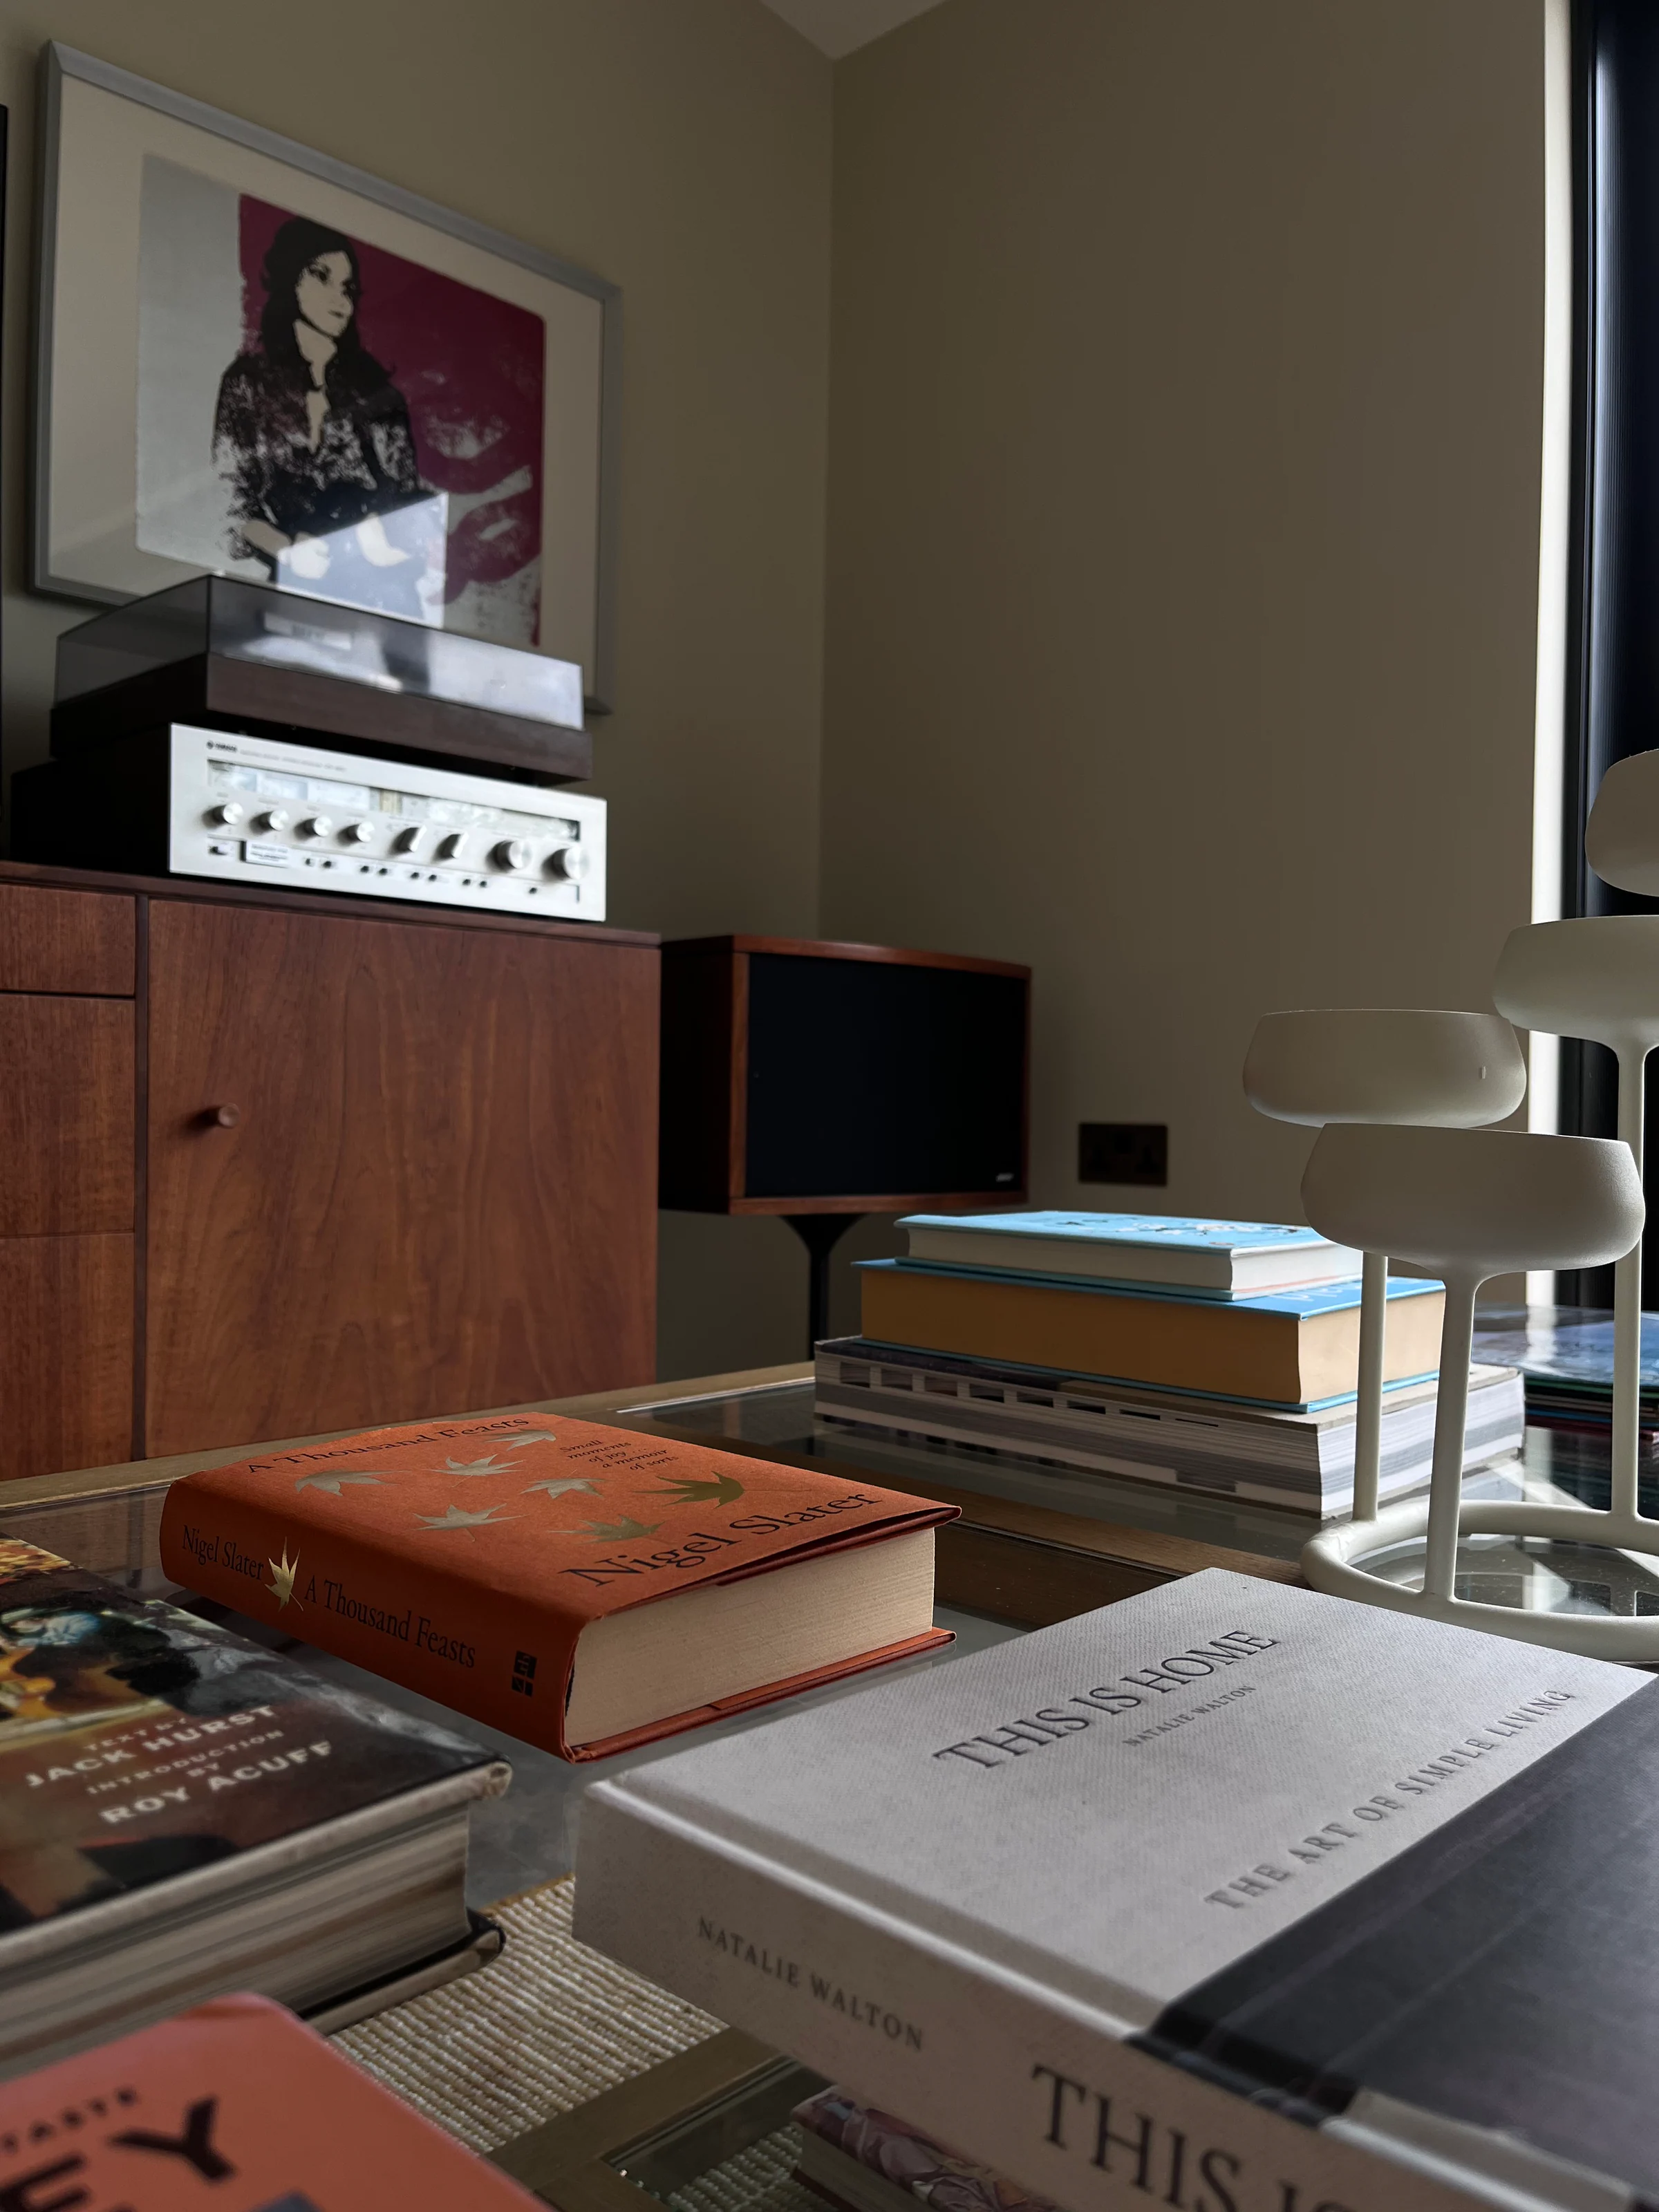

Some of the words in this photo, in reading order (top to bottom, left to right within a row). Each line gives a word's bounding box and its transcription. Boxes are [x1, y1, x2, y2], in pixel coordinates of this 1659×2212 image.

[248, 1463, 275, 1474] A
[272, 1434, 438, 1464] Thousand
[438, 1417, 529, 1438] Feasts
[559, 1440, 604, 1452] Small
[568, 1442, 632, 1459] moments
[589, 1455, 604, 1463] of
[605, 1452, 626, 1461] joy
[614, 1449, 668, 1465] memoir
[630, 1463, 646, 1471] of
[646, 1456, 679, 1467] sorts
[182, 1524, 219, 1566] Nigel
[221, 1541, 265, 1581] Slater
[559, 1532, 742, 1587] Nigel
[729, 1490, 883, 1536] Slater
[304, 1575, 318, 1604] A
[324, 1579, 412, 1642] Thousand
[415, 1615, 476, 1669] Feasts
[932, 1707, 1089, 1770] THIS
[1069, 1686, 1143, 1716] IS
[1119, 1629, 1283, 1694] HOME
[1122, 1712, 1196, 1747] NATALIE
[1195, 1684, 1257, 1716] WALTON
[25, 1749, 137, 1788] JACK
[142, 1705, 276, 1752] HURST
[84, 1728, 148, 1751] TEXT
[155, 1716, 187, 1731] BY
[86, 1729, 285, 1795] INTRODUCTION
[99, 1786, 191, 1824] ROY
[207, 1740, 332, 1792] ACUFF
[186, 1761, 221, 1779] BY
[1203, 1862, 1291, 1910] THE
[1288, 1821, 1358, 1865] ART
[1353, 1794, 1405, 1821] OF
[1395, 1736, 1497, 1795] SIMPLE
[1493, 1689, 1575, 1738] LIVING
[697, 1915, 800, 1989] NATALIE
[810, 1972, 925, 2052] WALTON
[1032, 2062, 1241, 2212] THIS
